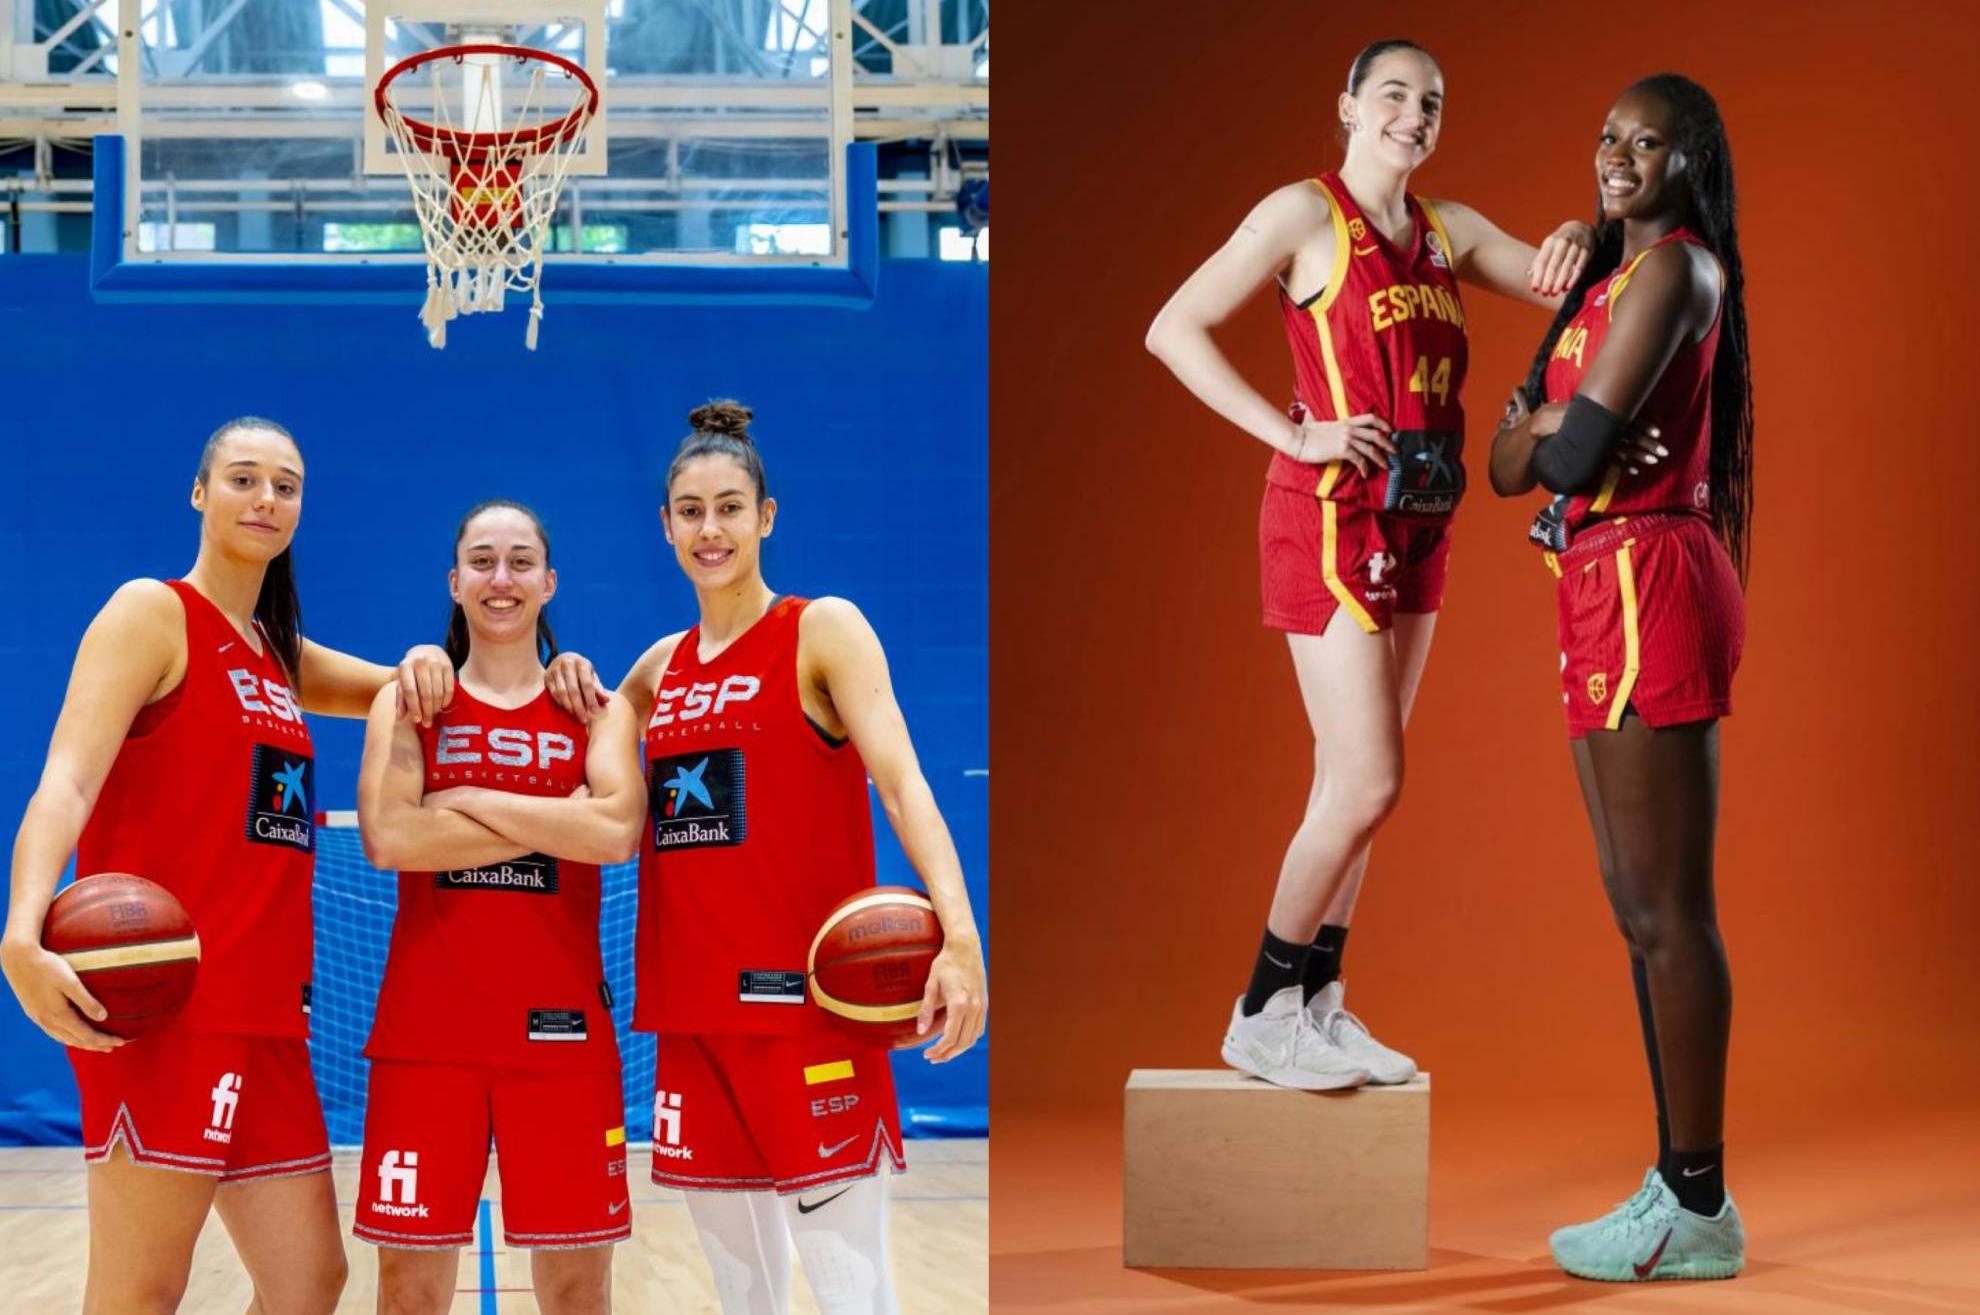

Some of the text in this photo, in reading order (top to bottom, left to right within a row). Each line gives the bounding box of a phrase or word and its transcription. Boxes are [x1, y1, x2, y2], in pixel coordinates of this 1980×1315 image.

[1409, 355, 1451, 407] 44
[648, 674, 762, 729] ESP
[649, 721, 762, 743] SKETBALL
[436, 724, 576, 770] ESP
[448, 864, 546, 889] CaixaBank
[810, 1094, 860, 1118] ESP
[377, 1149, 418, 1205] fi
[608, 1159, 625, 1177] ES
[371, 1202, 430, 1218] network
